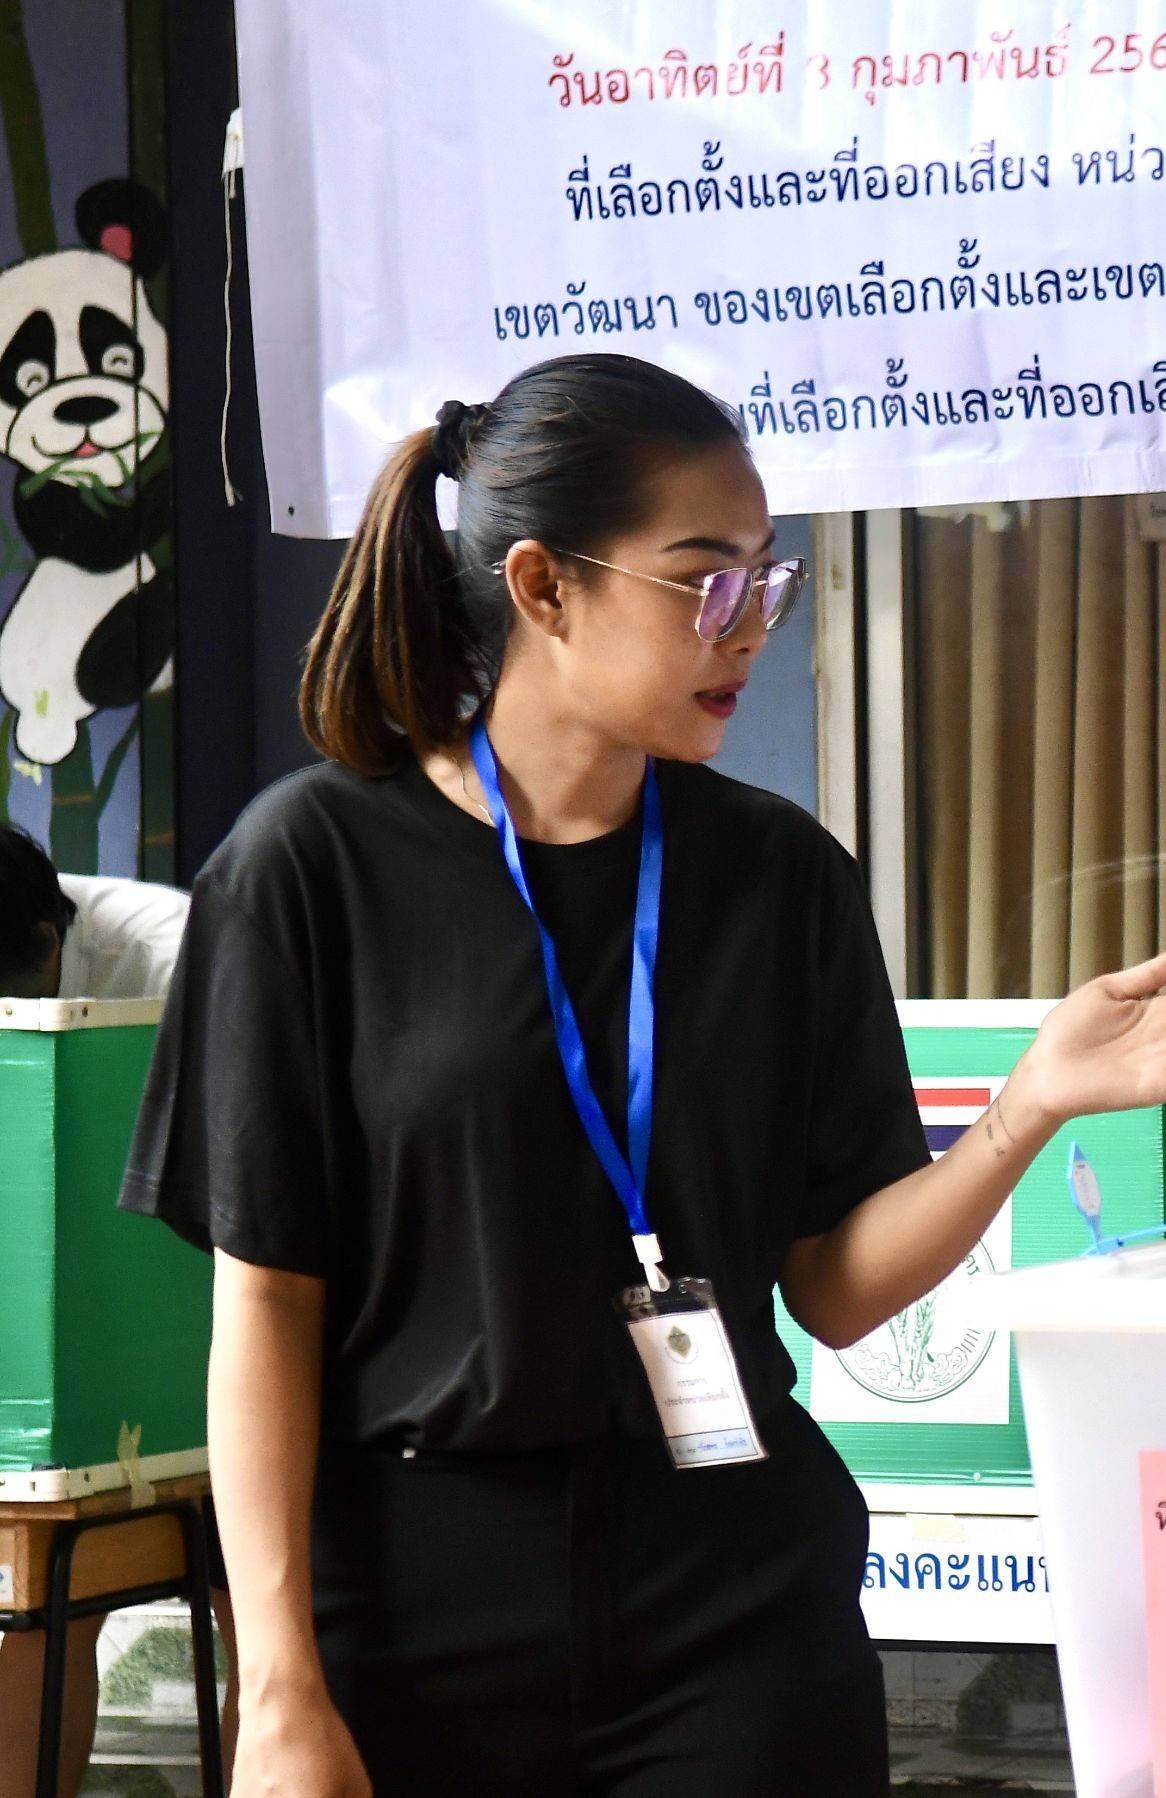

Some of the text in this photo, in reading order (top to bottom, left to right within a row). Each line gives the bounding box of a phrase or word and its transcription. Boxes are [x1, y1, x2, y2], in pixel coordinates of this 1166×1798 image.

[548, 30, 785, 108] วันอาทิตย์ที่
[852, 22, 1072, 106] กุมภาพันธ์
[565, 137, 1050, 221] ที่เลือกตั้งและที่ออกเสียง
[493, 281, 679, 340] เขตวัฒนา
